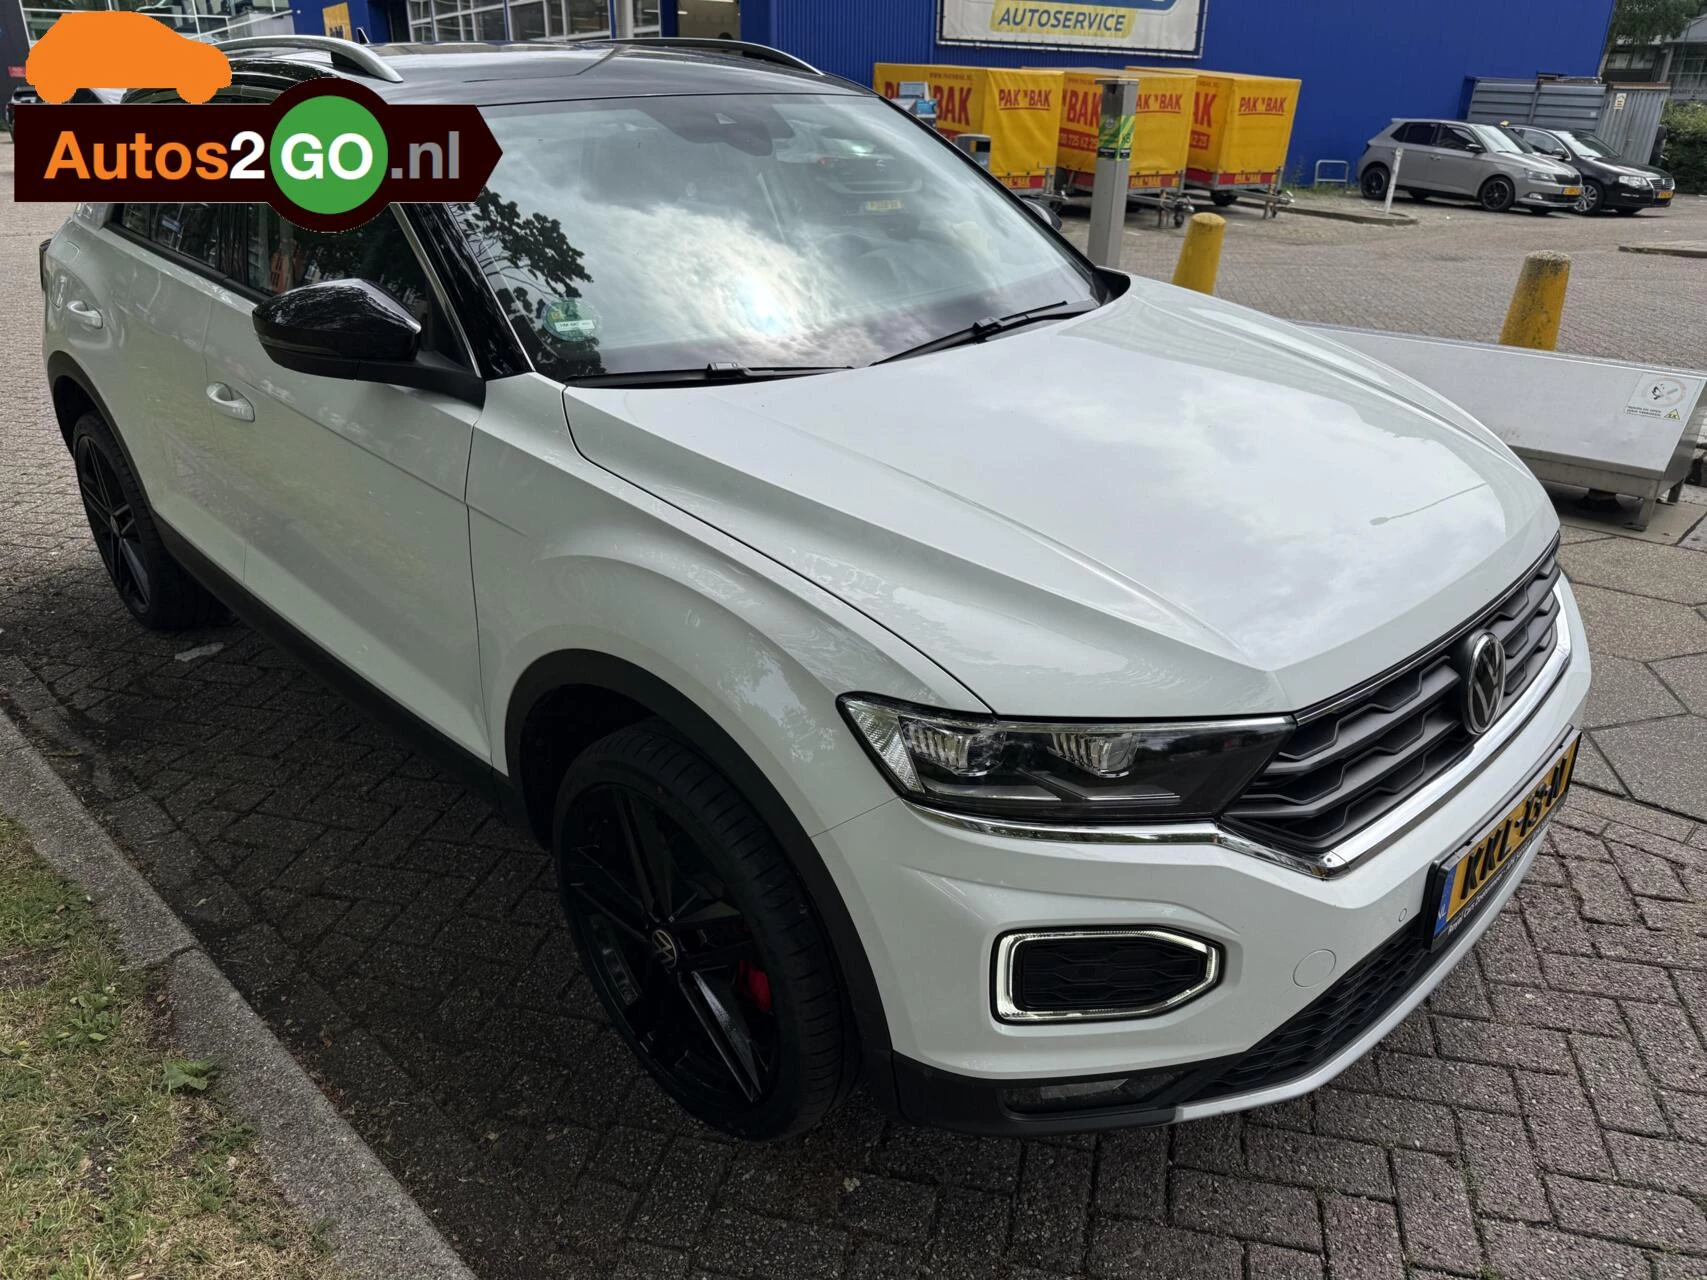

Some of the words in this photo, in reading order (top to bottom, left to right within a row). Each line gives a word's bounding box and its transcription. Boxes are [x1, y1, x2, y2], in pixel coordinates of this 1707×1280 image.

[998, 8, 1126, 32] AUTOSERVICE
[999, 89, 1021, 106] PAK
[1028, 89, 1052, 107] BAK
[1159, 94, 1182, 110] BAK
[1239, 96, 1259, 112] PAK
